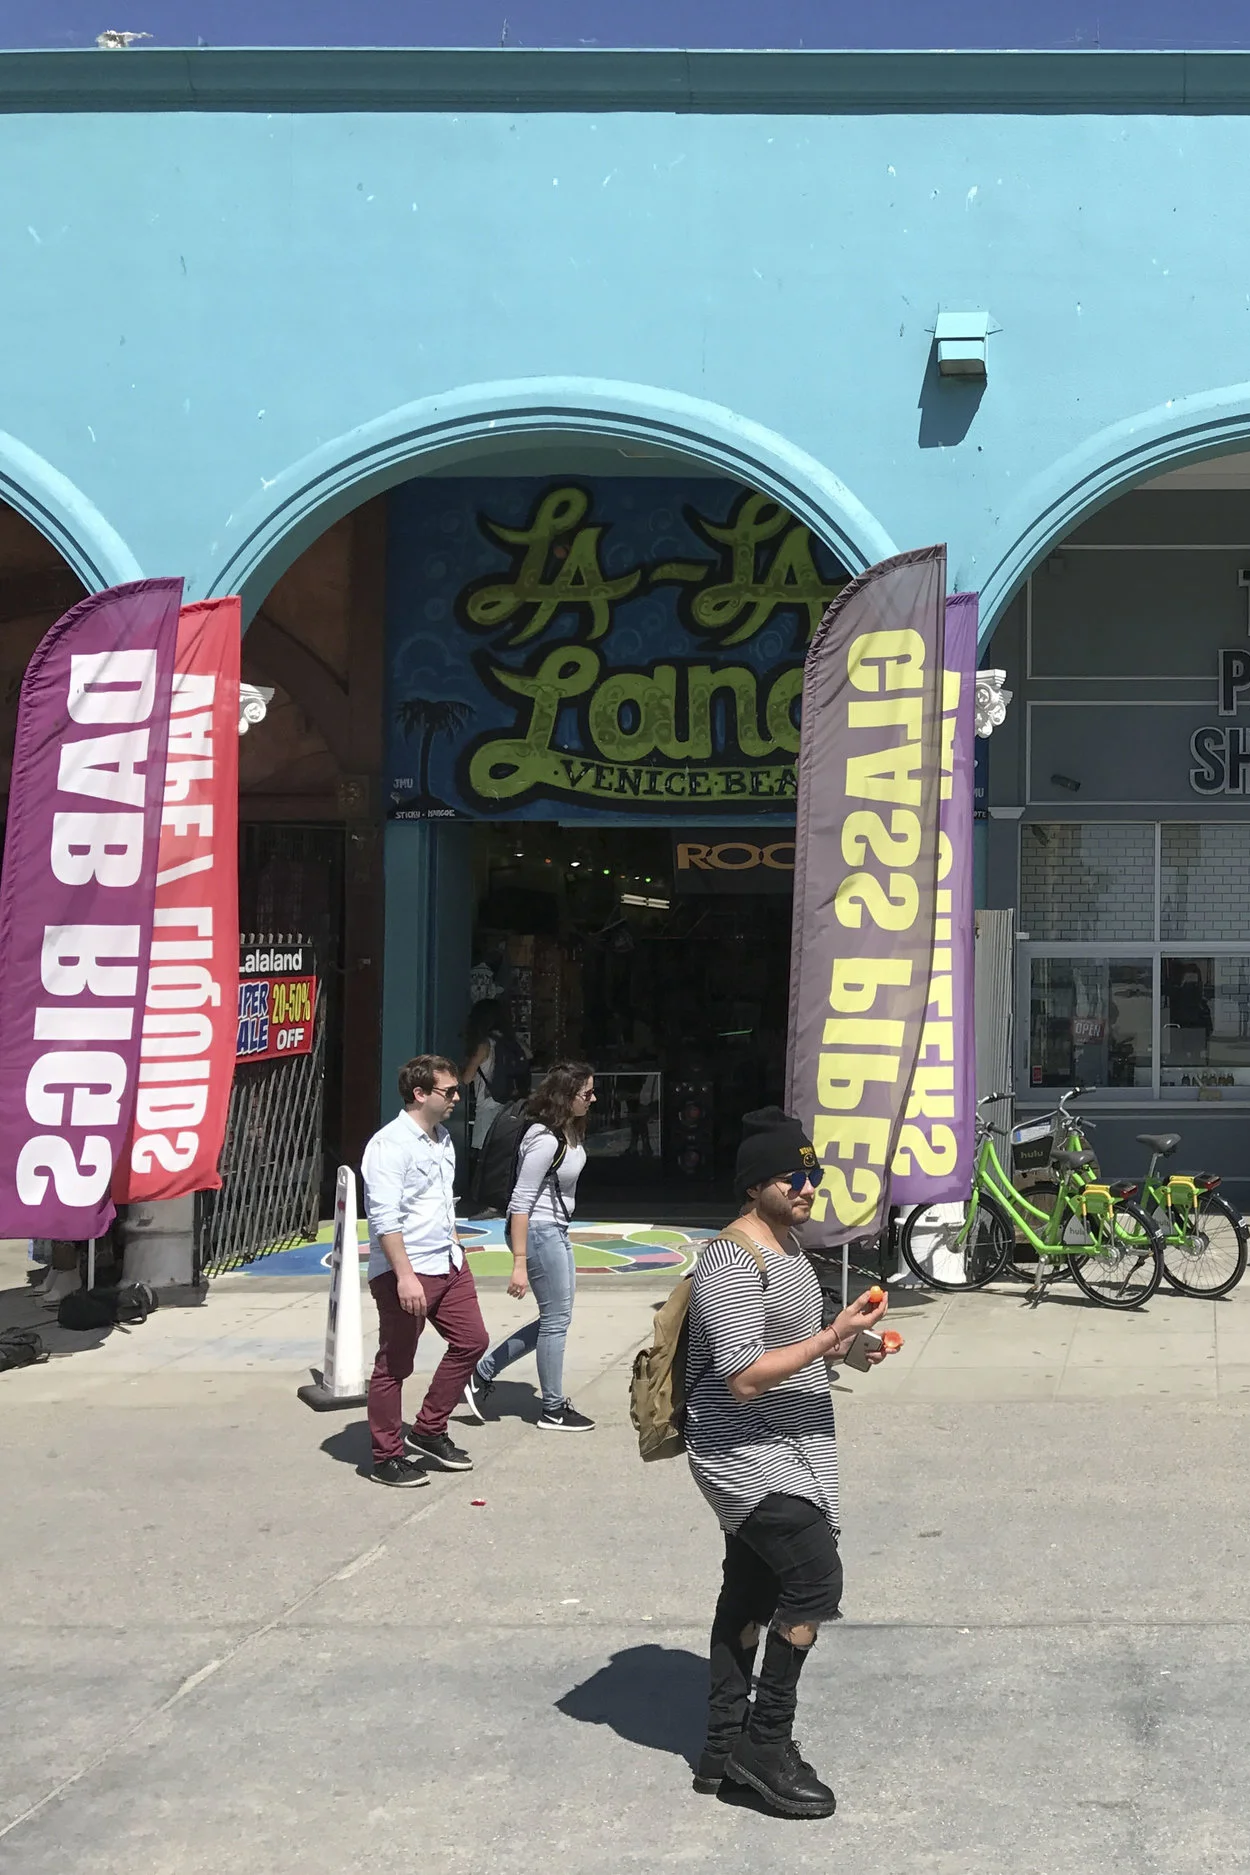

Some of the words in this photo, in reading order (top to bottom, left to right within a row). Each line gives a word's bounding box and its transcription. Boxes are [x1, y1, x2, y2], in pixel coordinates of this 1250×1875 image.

[561, 760, 712, 797] VENICE
[717, 769, 797, 796] BEA
[238, 981, 270, 1019] PER
[272, 982, 311, 1025] 20-50%
[237, 1017, 269, 1056] ALE
[277, 1028, 304, 1050] OFF
[1075, 1022, 1101, 1037] OPEN
[1020, 1150, 1044, 1158] hulu
[328, 1222, 343, 1335] ATM
